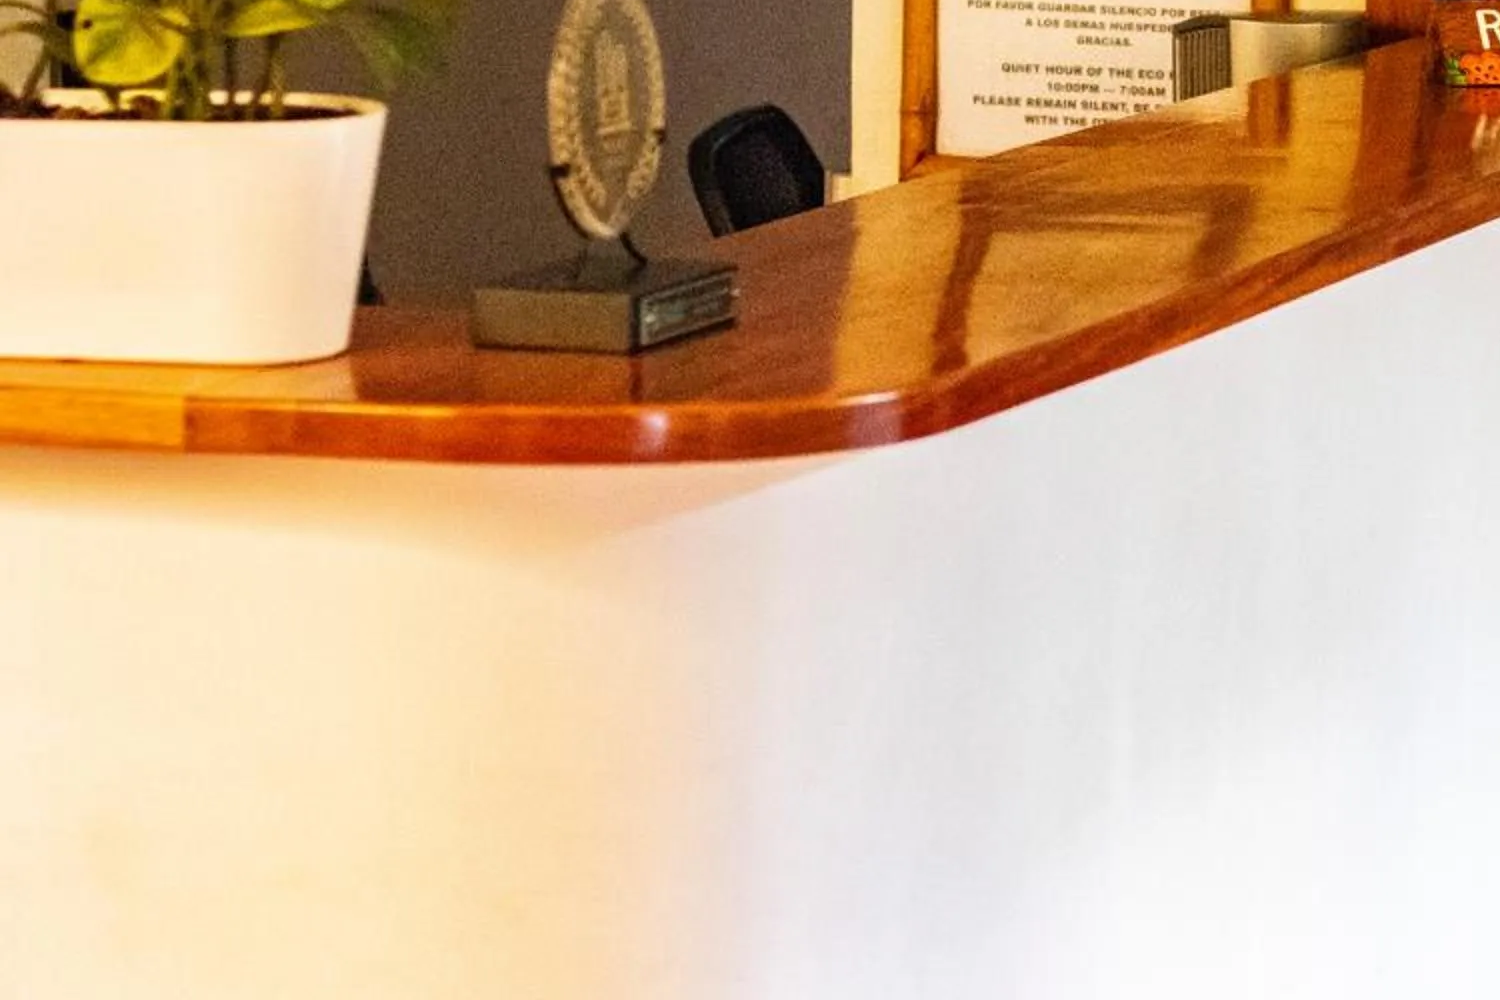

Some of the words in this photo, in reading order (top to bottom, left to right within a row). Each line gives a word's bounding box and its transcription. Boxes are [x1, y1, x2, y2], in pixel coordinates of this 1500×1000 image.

[995, 0, 1033, 11] FAVOR
[1037, 2, 1096, 14] GUARDAR
[1100, 6, 1157, 17] SILENCIO
[1160, 7, 1185, 18] POR
[1025, 18, 1033, 27] A
[1037, 18, 1060, 28] LOS
[1064, 19, 1106, 30] DEMAS
[1001, 62, 1041, 74] QUIET
[1045, 65, 1083, 76] HOUR
[1086, 66, 1104, 77] OF
[1108, 68, 1133, 79] THE
[1137, 69, 1165, 80] ECO
[1047, 81, 1100, 94] 10:00PM
[1119, 85, 1166, 97] 7:00AM
[972, 95, 1022, 107] PLEASE
[1026, 97, 1077, 110] REMAIN
[1133, 103, 1149, 113] BE
[1024, 115, 1059, 126] WITH
[1063, 116, 1088, 127] THE
